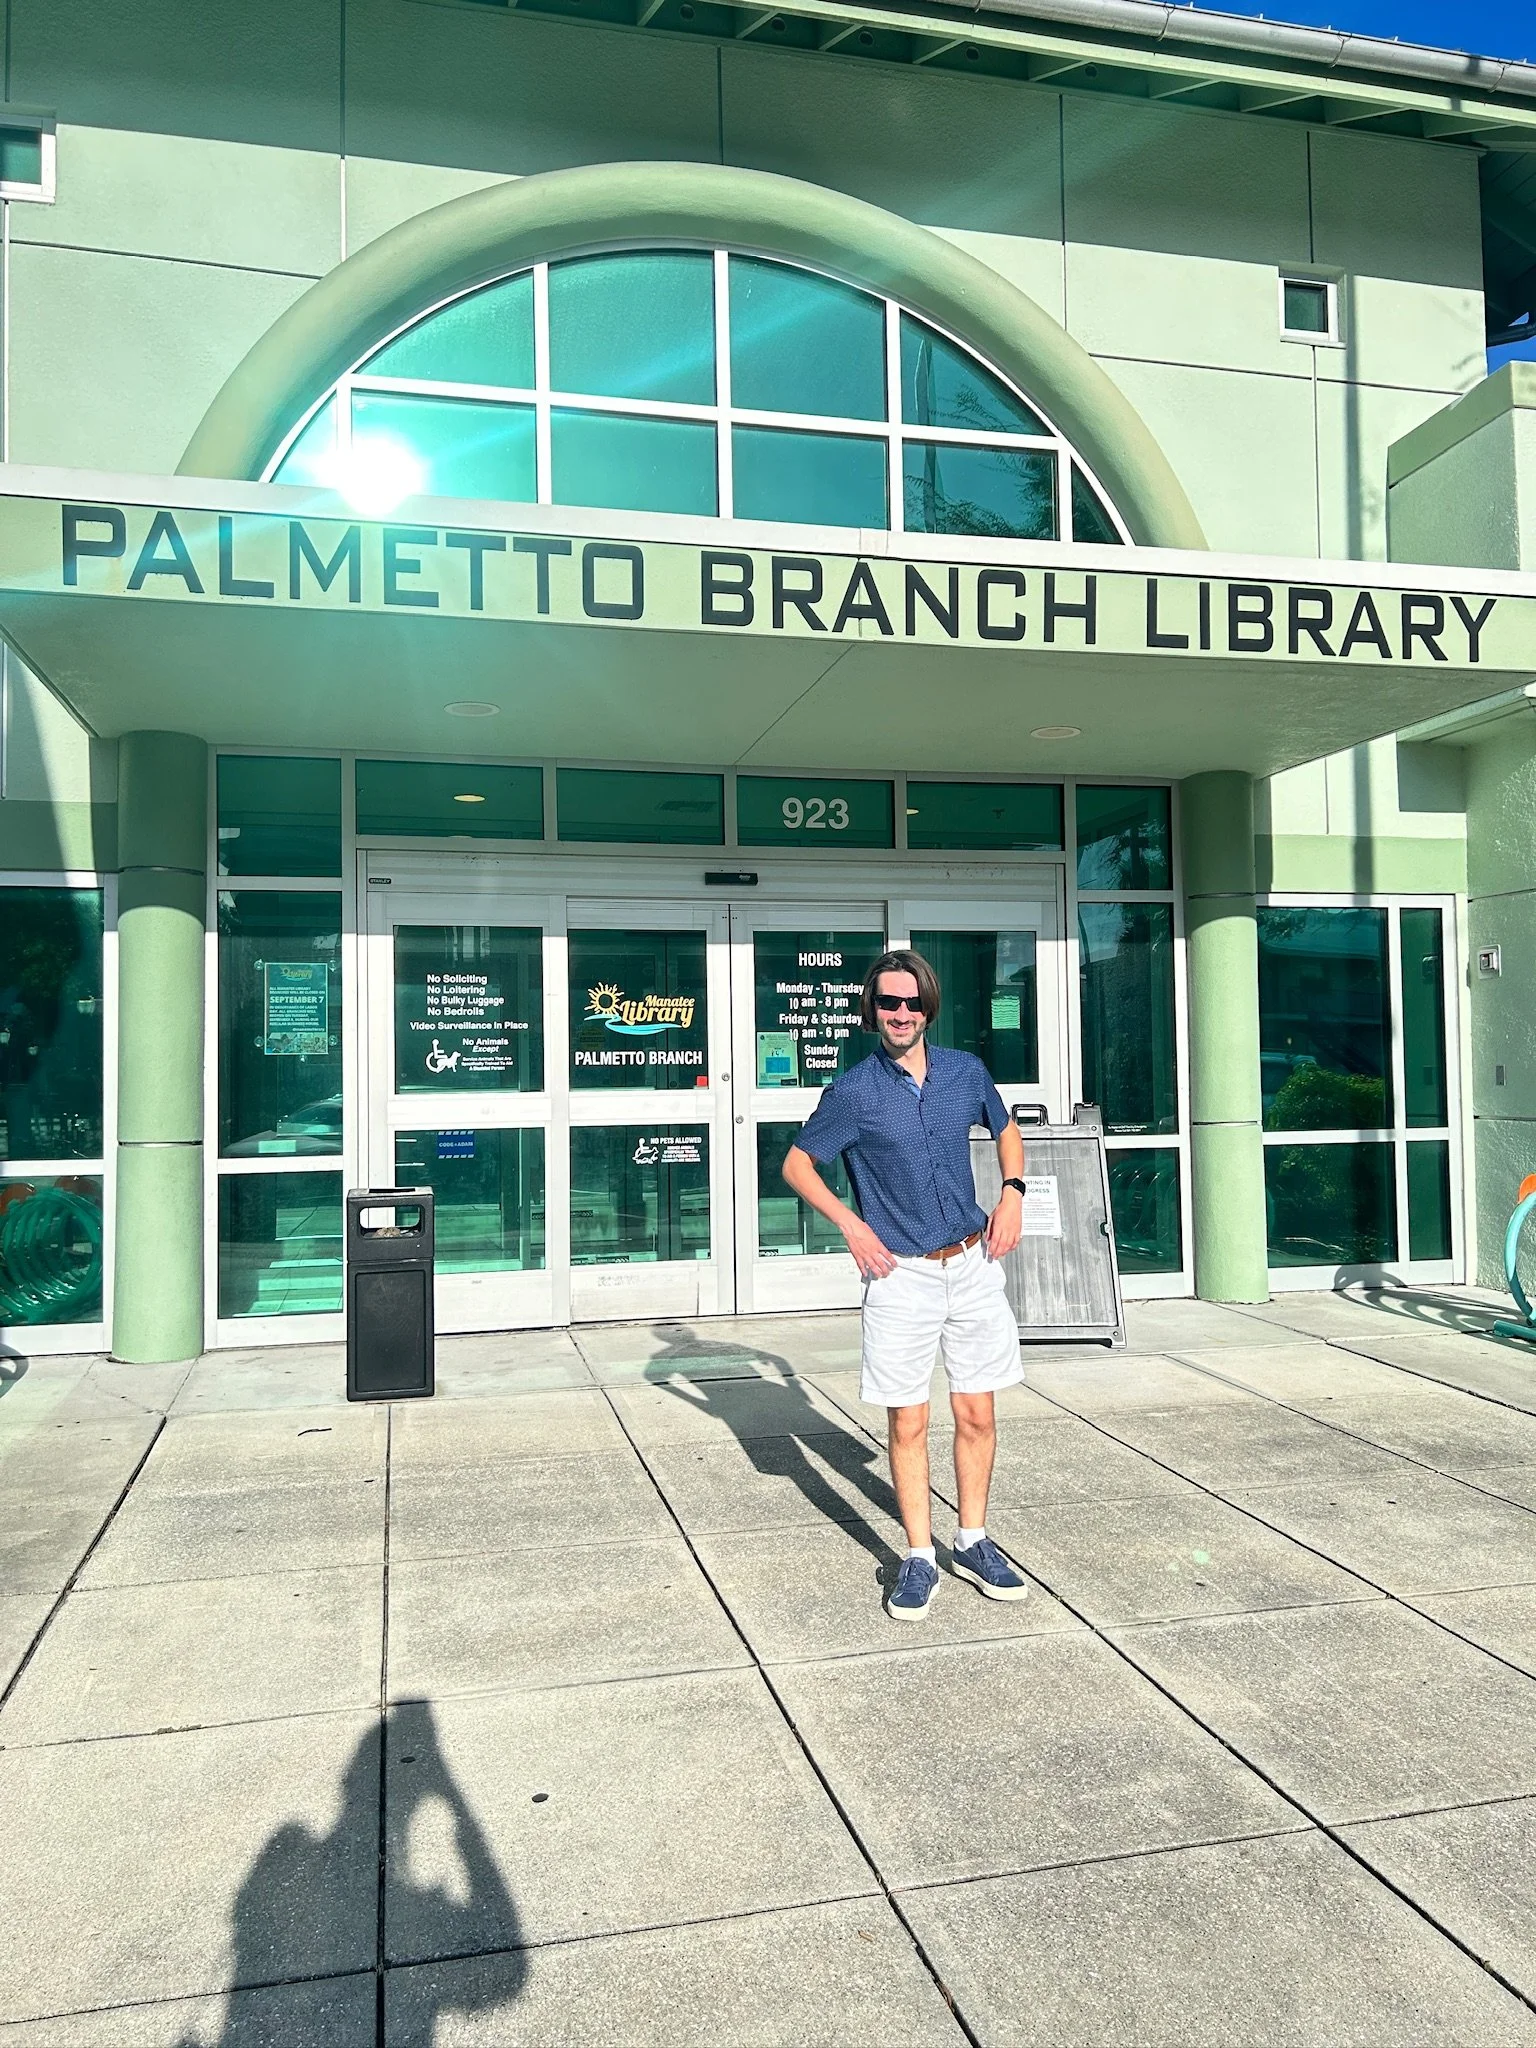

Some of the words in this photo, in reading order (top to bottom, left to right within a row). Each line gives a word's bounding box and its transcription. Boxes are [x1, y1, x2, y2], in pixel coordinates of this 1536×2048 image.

[61, 503, 644, 620] PALMETTO
[700, 550, 1097, 646] BRANCH
[1145, 577, 1497, 664] LIBRARY
[782, 797, 850, 830] 923
[798, 952, 843, 967] HOURS
[427, 974, 441, 983] No
[443, 974, 488, 985] Soliciting
[427, 985, 441, 994] No
[443, 985, 486, 996] Loitering
[776, 982, 814, 995] Monday
[821, 982, 865, 995] Thursday
[270, 996, 318, 1004] SEPTEMBER
[427, 996, 440, 1005] No
[441, 996, 466, 1006] Bulky
[468, 996, 505, 1007] Luggage
[645, 995, 695, 1007] Manatee
[789, 997, 799, 1010] 10
[801, 998, 816, 1007] am
[825, 996, 832, 1007] 8
[833, 998, 849, 1009] pm
[427, 1007, 441, 1016] No
[443, 1007, 485, 1016] Bedrolls
[620, 1000, 695, 1028] Library
[410, 1022, 435, 1030] Video
[437, 1022, 492, 1030] Surveillance
[504, 1021, 529, 1029] Place
[779, 1013, 809, 1026] Friday
[811, 1014, 819, 1024] &
[821, 1013, 863, 1026] Saturday
[789, 1028, 799, 1041] 10
[801, 1028, 817, 1038] am
[825, 1027, 832, 1038] 6
[834, 1028, 850, 1040] pm
[472, 1045, 499, 1053] Except
[804, 1044, 839, 1057] Sunday
[575, 1051, 645, 1066] PALMETTO
[649, 1051, 703, 1065] BRANCH
[805, 1057, 838, 1069] Closed
[674, 1136, 702, 1144] ALLOWED
